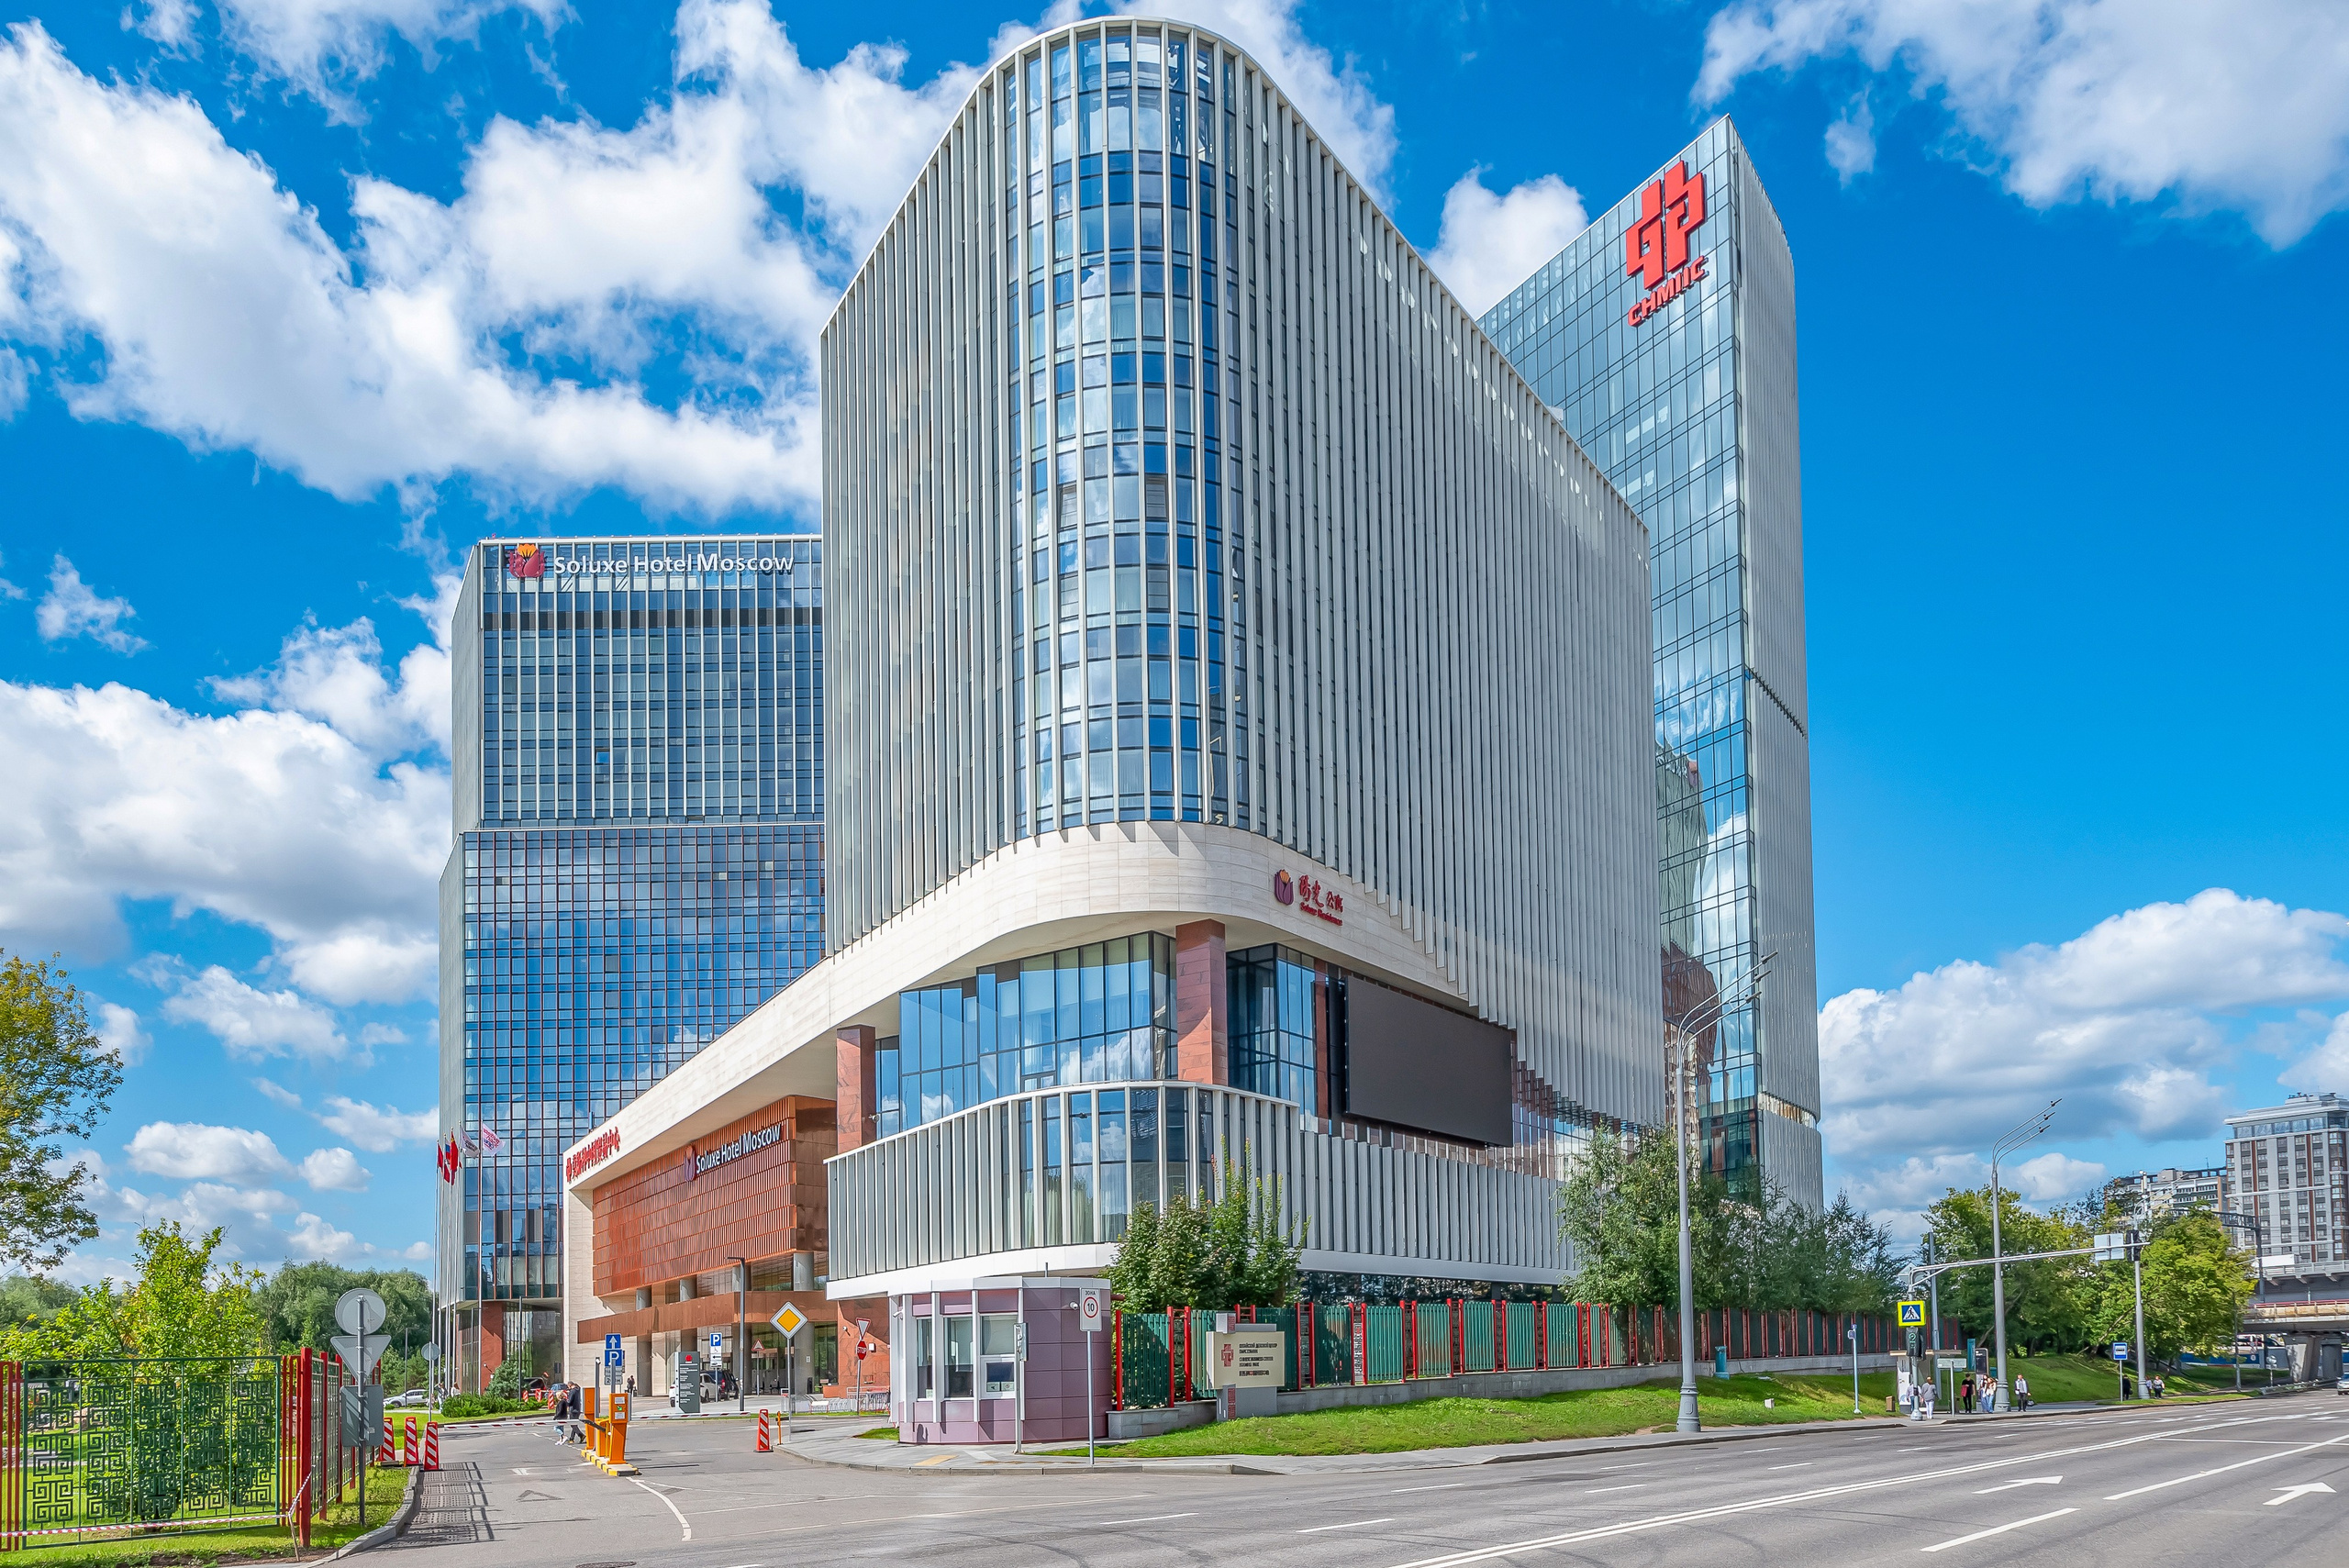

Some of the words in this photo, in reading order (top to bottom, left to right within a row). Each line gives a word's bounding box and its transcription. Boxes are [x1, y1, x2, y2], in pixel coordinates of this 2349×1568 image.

[554, 555, 628, 574] Soluxe
[634, 553, 691, 573] Hotel
[697, 552, 795, 573] Moscow
[696, 1150, 720, 1174] Soluxe
[721, 1135, 741, 1163] Hotel
[742, 1124, 782, 1154] Moscow
[1087, 1303, 1095, 1312] 10
